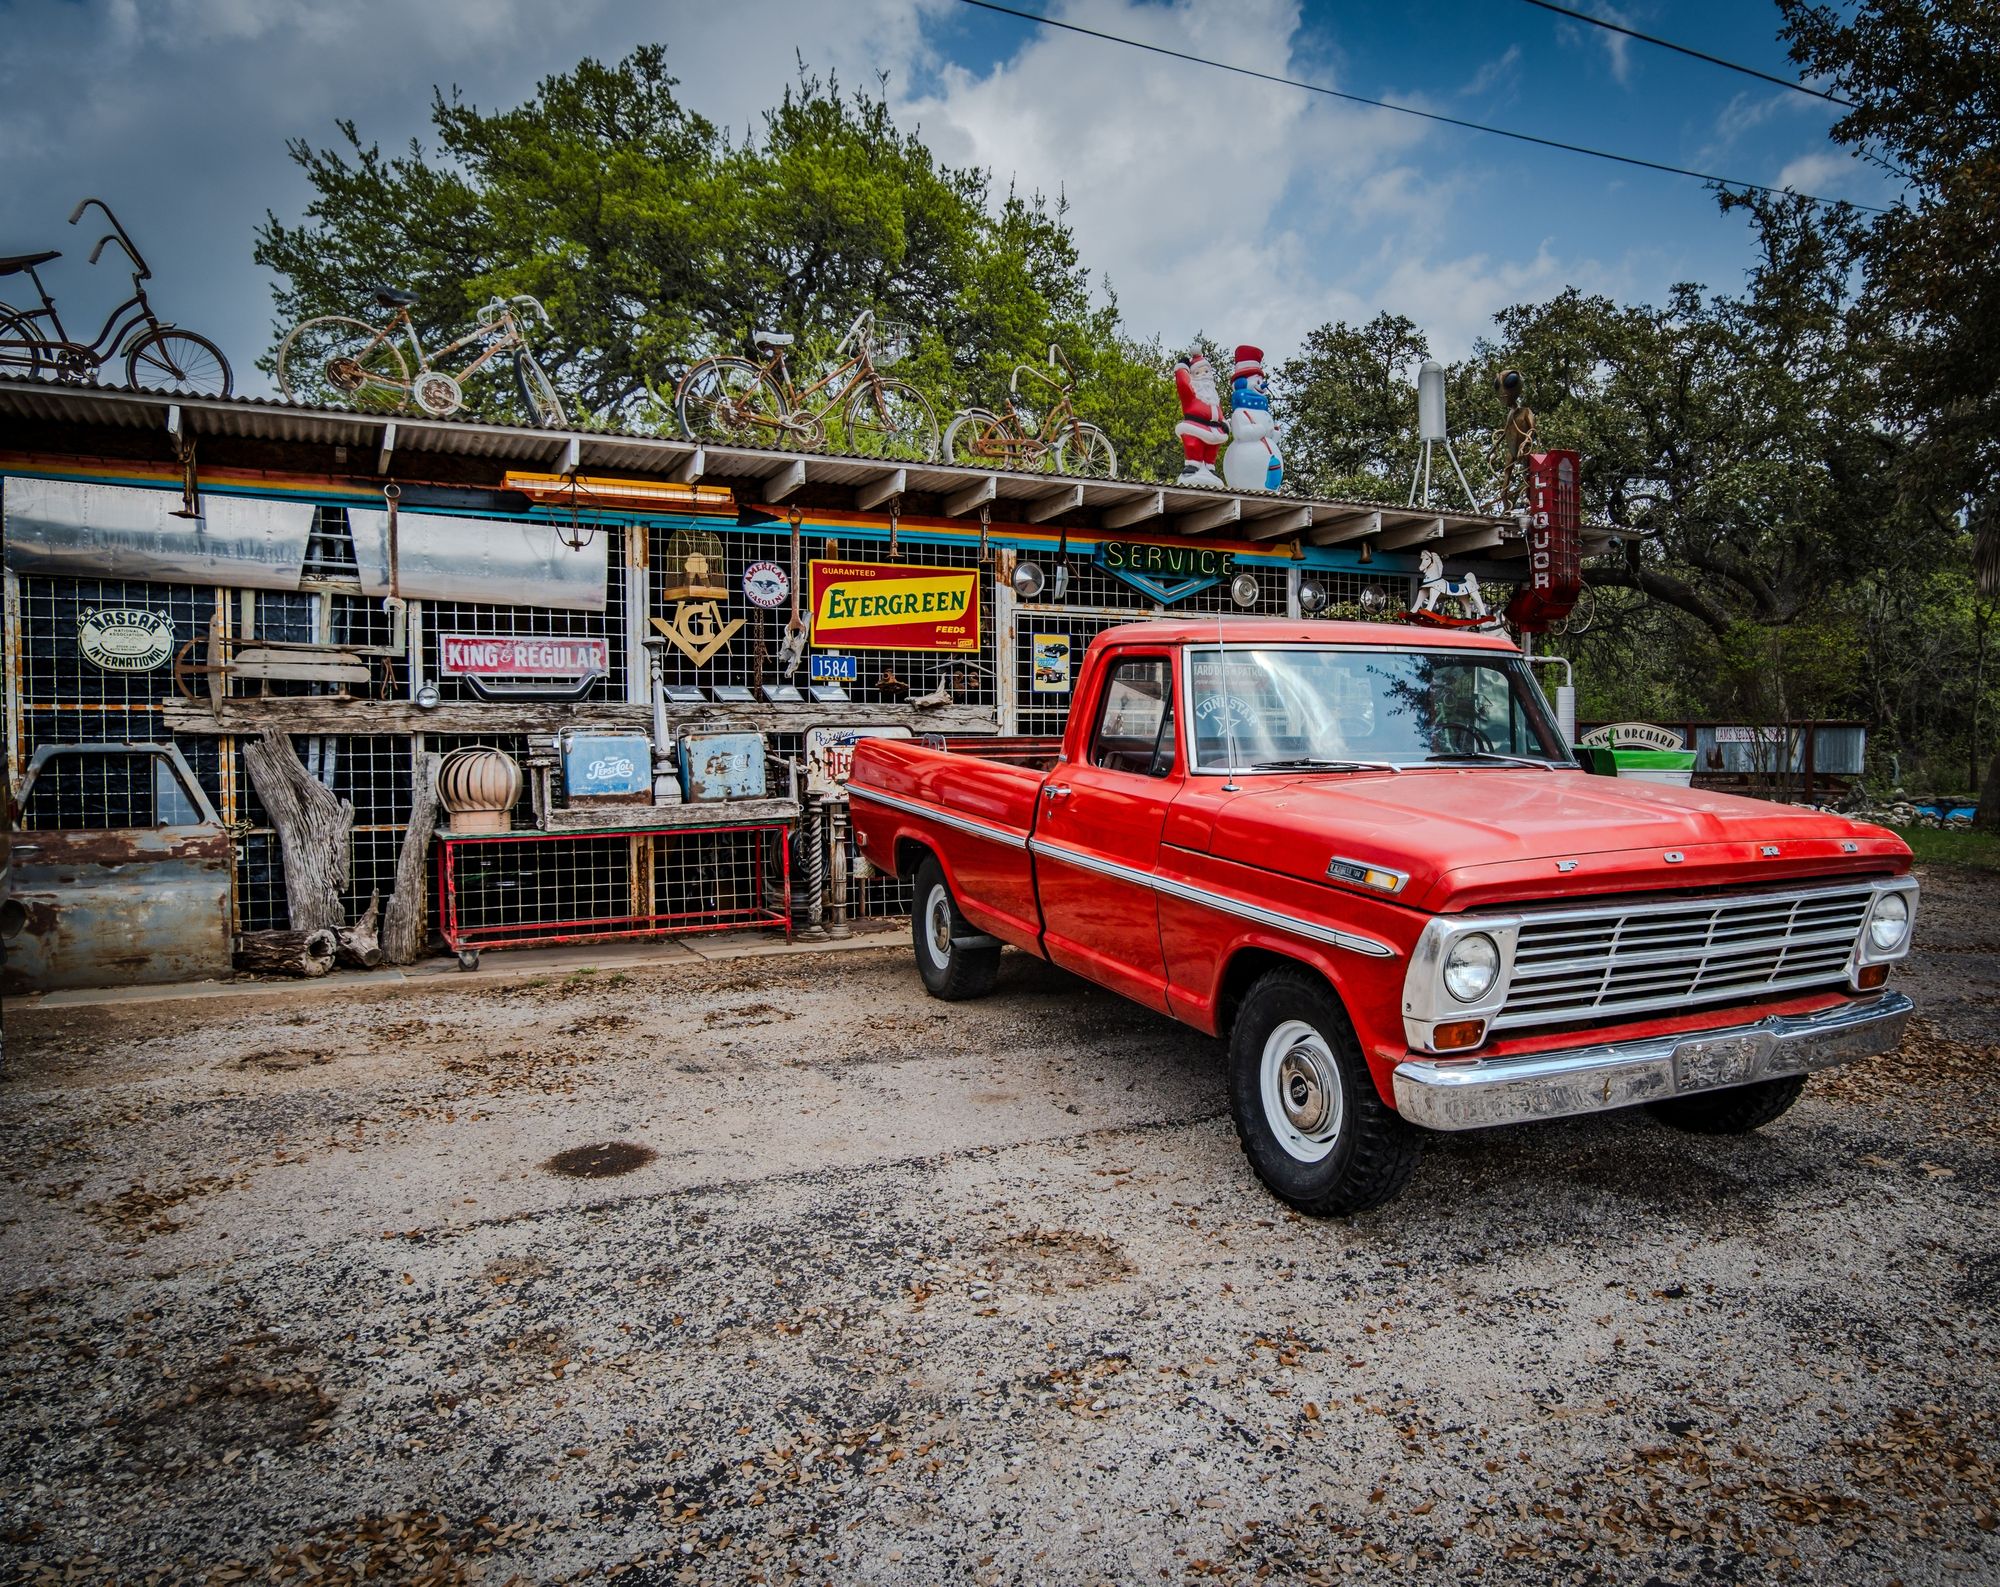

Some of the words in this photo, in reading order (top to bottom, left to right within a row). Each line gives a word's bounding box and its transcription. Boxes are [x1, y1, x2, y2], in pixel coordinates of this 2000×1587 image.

[1533, 472, 1550, 589] LIQUOR
[1107, 542, 1232, 575] SERVICE
[745, 563, 787, 584] AMERICAN
[822, 567, 876, 577] GUARANTEED
[748, 590, 786, 606] GASOLINE
[89, 612, 162, 634] NASCAR
[935, 625, 966, 634] FEEDS
[88, 646, 167, 668] INTERNATIONAL
[449, 642, 499, 667] KING
[500, 649, 513, 663] &
[514, 646, 602, 668] REGULAR
[819, 659, 849, 677] 1584
[1588, 728, 1622, 746] ENGL
[1624, 728, 1675, 749] ORCHARD
[1556, 842, 1858, 872] FORD
